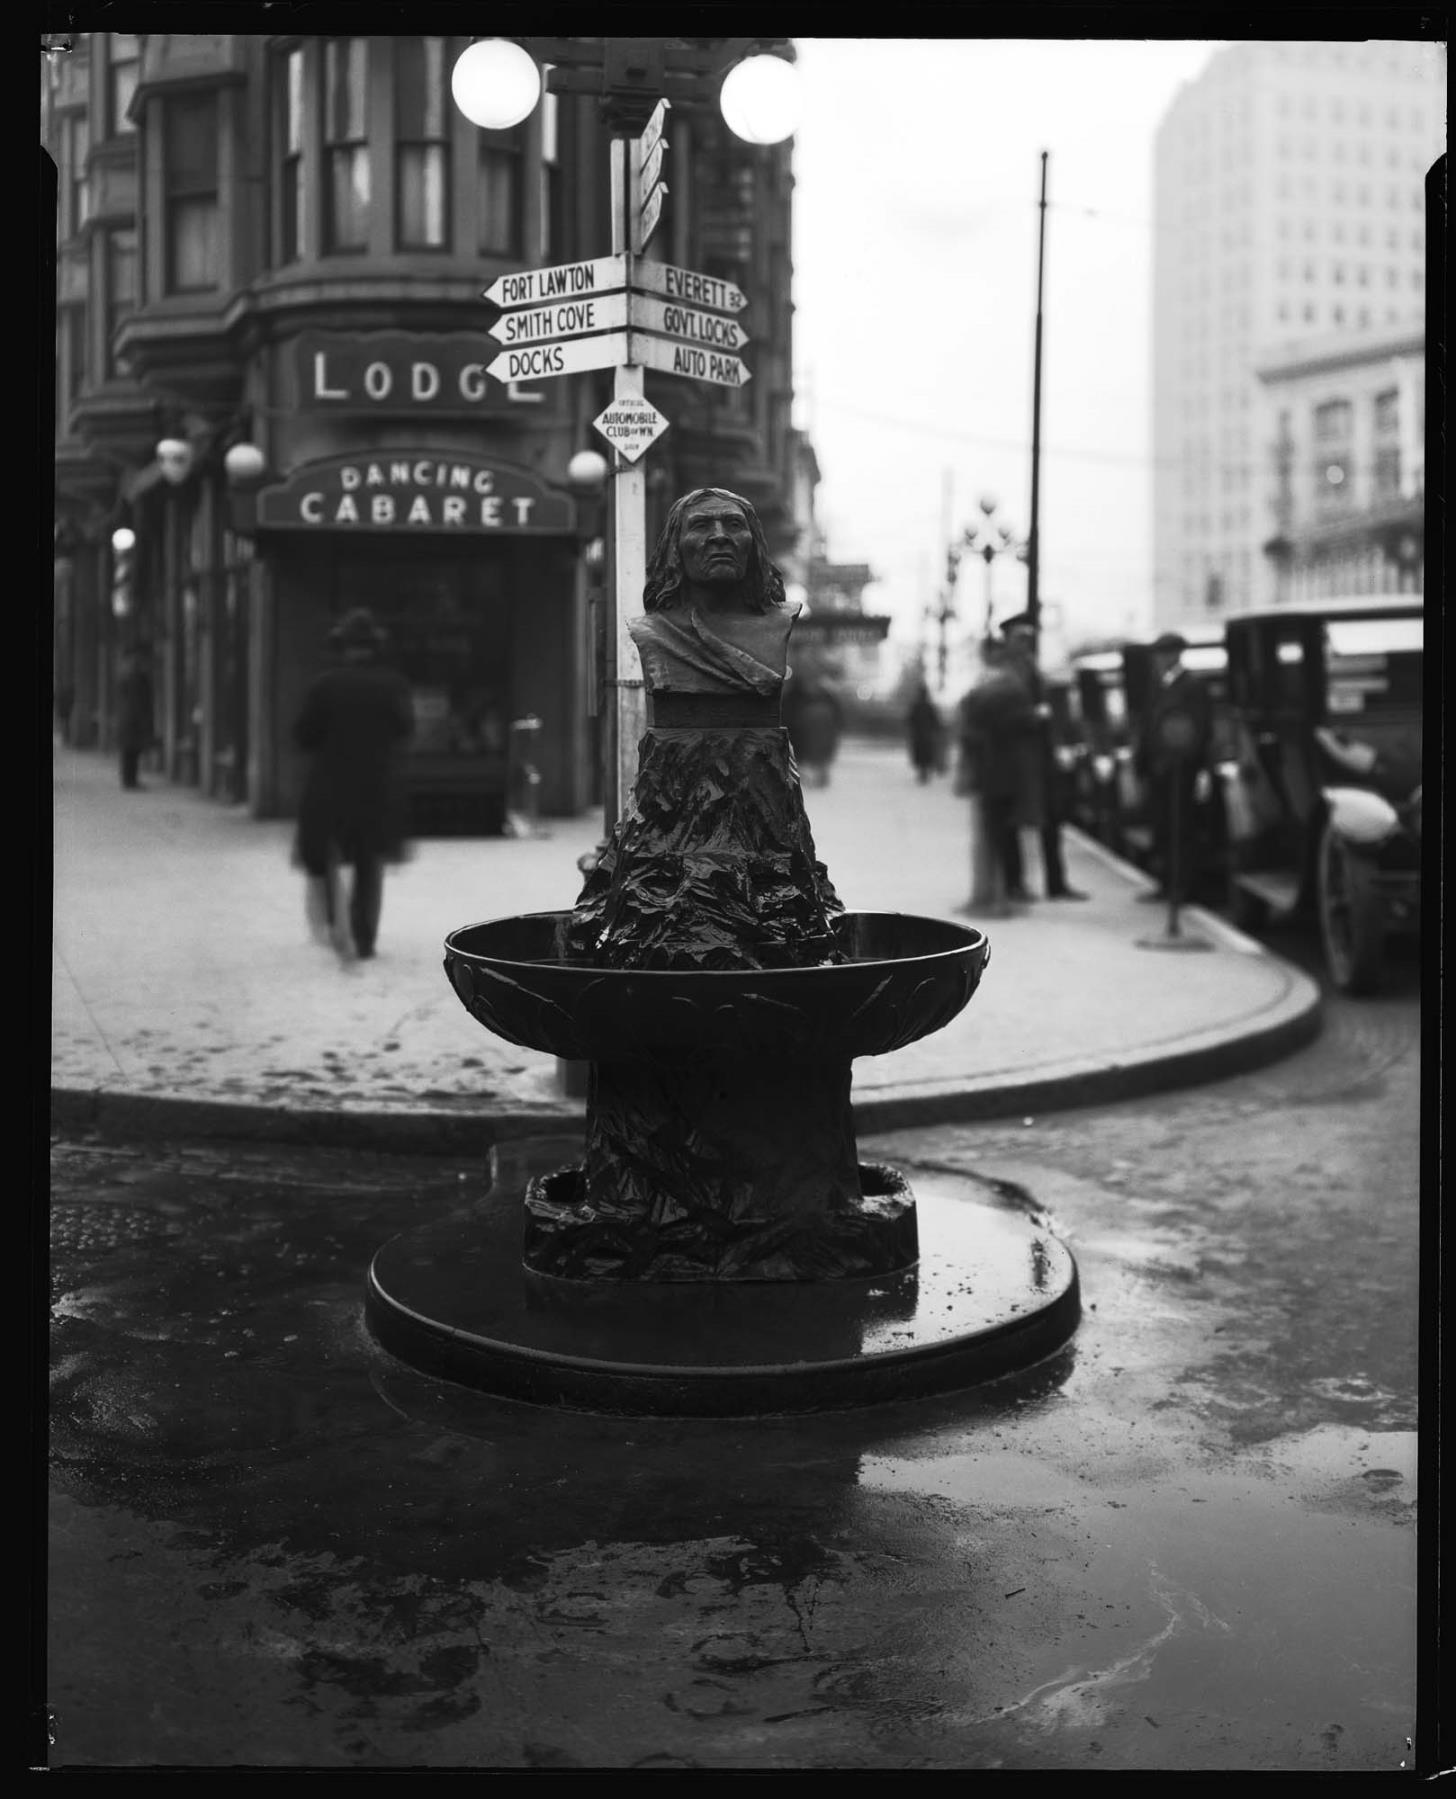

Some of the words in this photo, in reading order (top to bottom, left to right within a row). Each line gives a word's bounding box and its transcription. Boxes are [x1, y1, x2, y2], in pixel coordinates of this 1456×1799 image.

[502, 275, 533, 303] FORT
[539, 264, 595, 297] LAWTON
[665, 267, 726, 308] EVERETT
[728, 291, 741, 308] 32
[506, 309, 553, 341] SMITH
[557, 302, 595, 332] COVE
[699, 314, 738, 348] LOCKS
[509, 346, 564, 378] DOCKS
[673, 346, 706, 378] AUTO
[709, 354, 741, 385] PARK
[602, 412, 657, 425] AUTOMOBILE
[606, 426, 630, 438] CLUB
[340, 461, 494, 494] DANCING
[300, 492, 535, 526] CABARET
